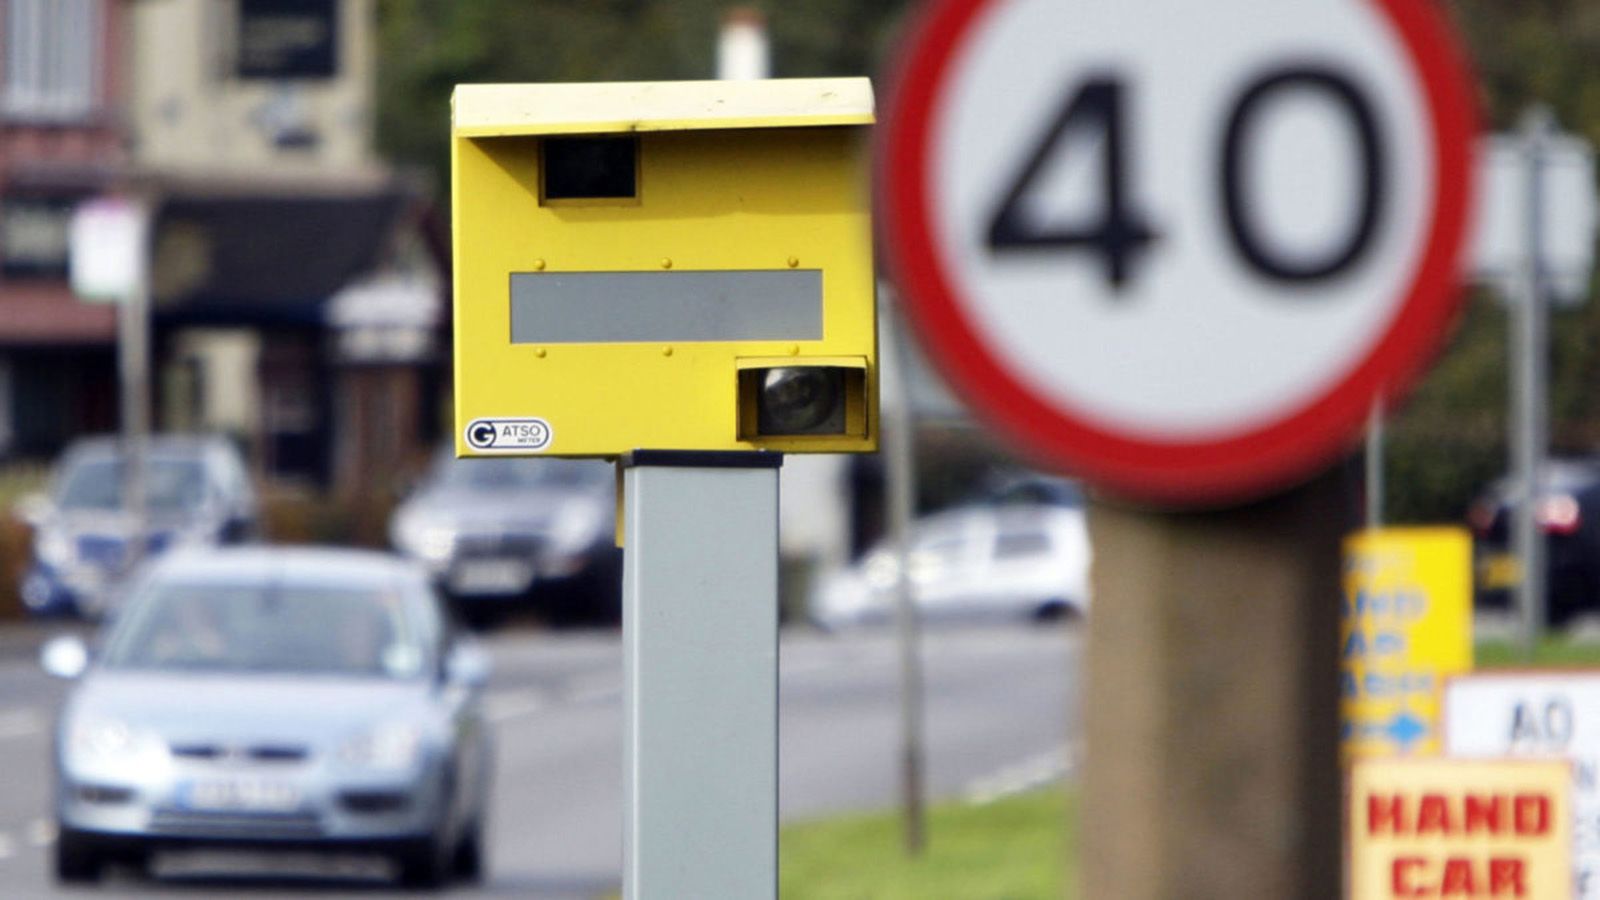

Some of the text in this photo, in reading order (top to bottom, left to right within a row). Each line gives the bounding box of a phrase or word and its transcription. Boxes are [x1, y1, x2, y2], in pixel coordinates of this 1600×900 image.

[984, 68, 1388, 290] 40
[1366, 793, 1552, 836] HAND
[1390, 857, 1526, 898] CAR
